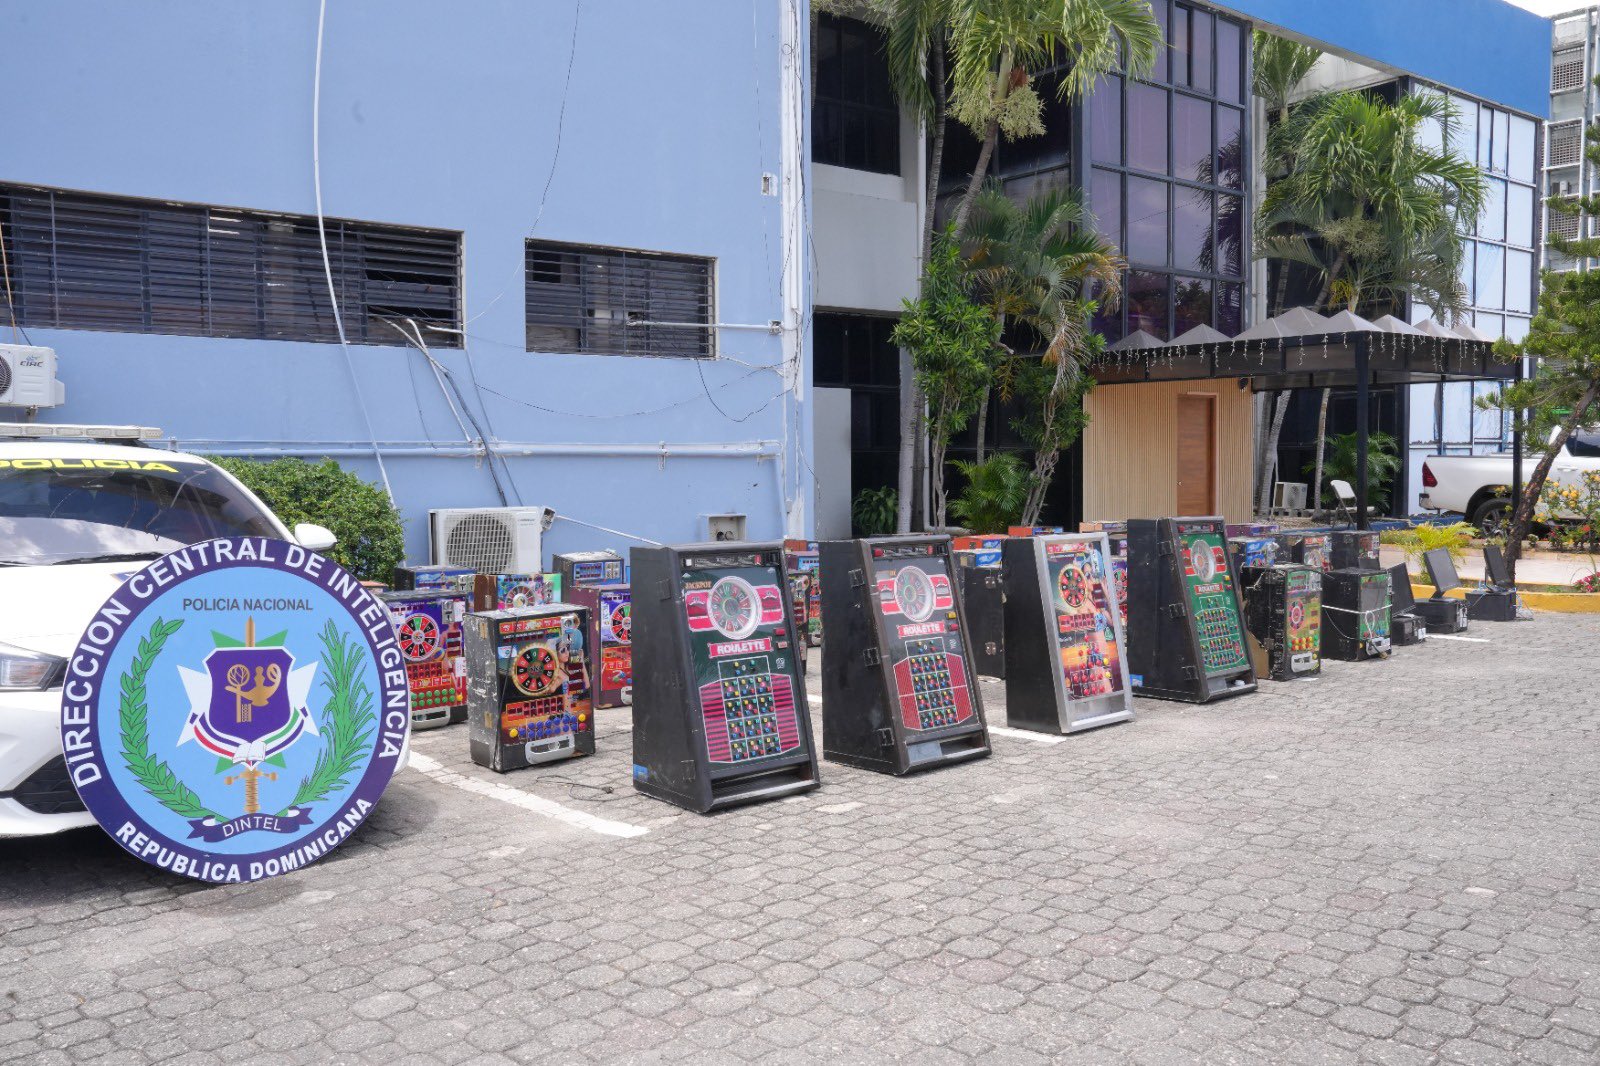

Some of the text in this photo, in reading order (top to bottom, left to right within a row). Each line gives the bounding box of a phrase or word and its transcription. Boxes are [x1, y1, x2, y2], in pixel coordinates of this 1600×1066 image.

[183, 598, 313, 612] POLICIA NACIONAL
[903, 623, 940, 635] ROULETTE
[717, 641, 766, 654] ROULETTE
[64, 538, 408, 788] DIRECCION CENTRAL DE INTELIGENCIA
[223, 816, 282, 835] DINTEL
[116, 798, 372, 882] REPUBLICA DOMINICANA
